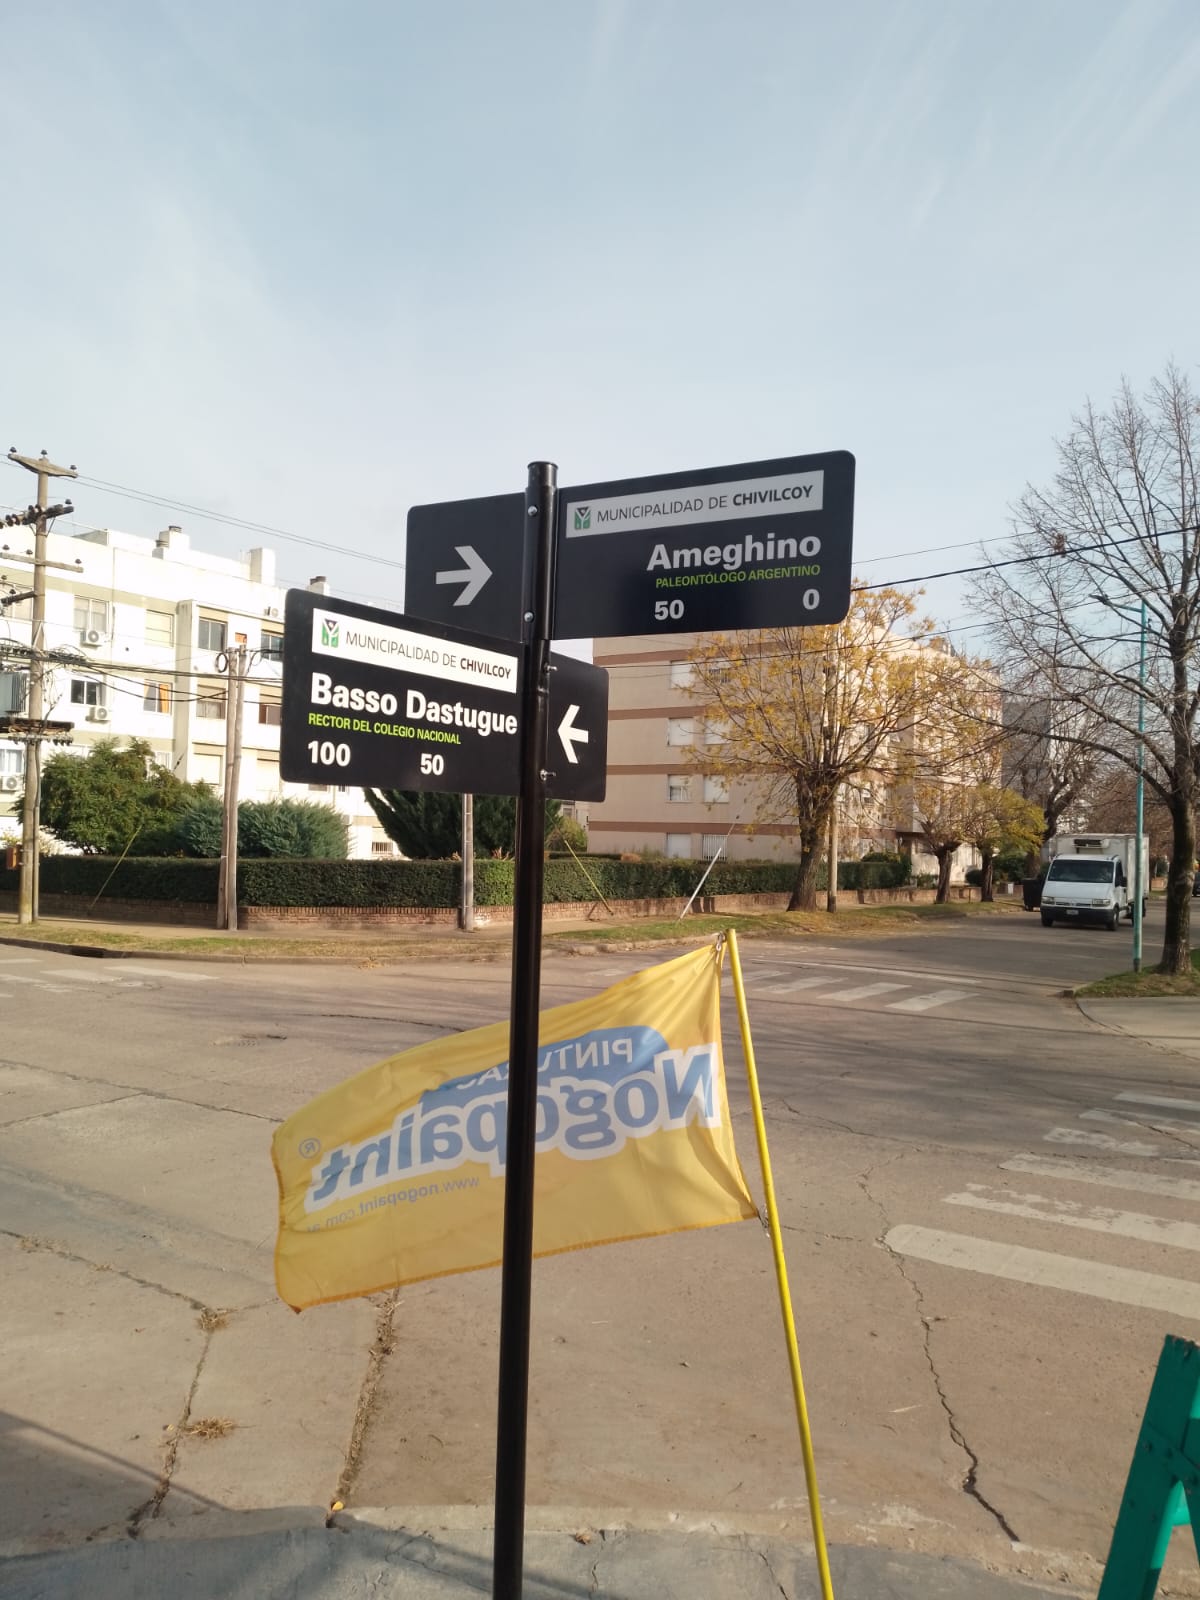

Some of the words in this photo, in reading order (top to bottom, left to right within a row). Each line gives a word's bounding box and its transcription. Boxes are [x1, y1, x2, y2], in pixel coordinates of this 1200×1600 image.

[597, 498, 703, 523] MUNICIPALIDAD
[708, 495, 728, 510] DE
[733, 485, 813, 507] CHIVILCOY
[647, 533, 821, 571] Ameghino
[655, 571, 747, 588] PALEONTÓLOGO
[748, 564, 821, 581] ARGENTINO
[654, 600, 684, 620] 50
[802, 588, 820, 610] 0
[345, 631, 440, 664] MUNICIPALIDAD
[442, 653, 457, 668] DE
[460, 657, 511, 680] CHIVILCOY
[310, 672, 398, 716] Basso
[406, 689, 518, 737] Dastugue
[308, 713, 351, 730] RECTOR
[352, 720, 372, 733] DEL
[373, 722, 415, 738] COLEGIO
[417, 728, 461, 745] NACIONAL
[307, 740, 351, 767] 100
[420, 753, 445, 775] 50
